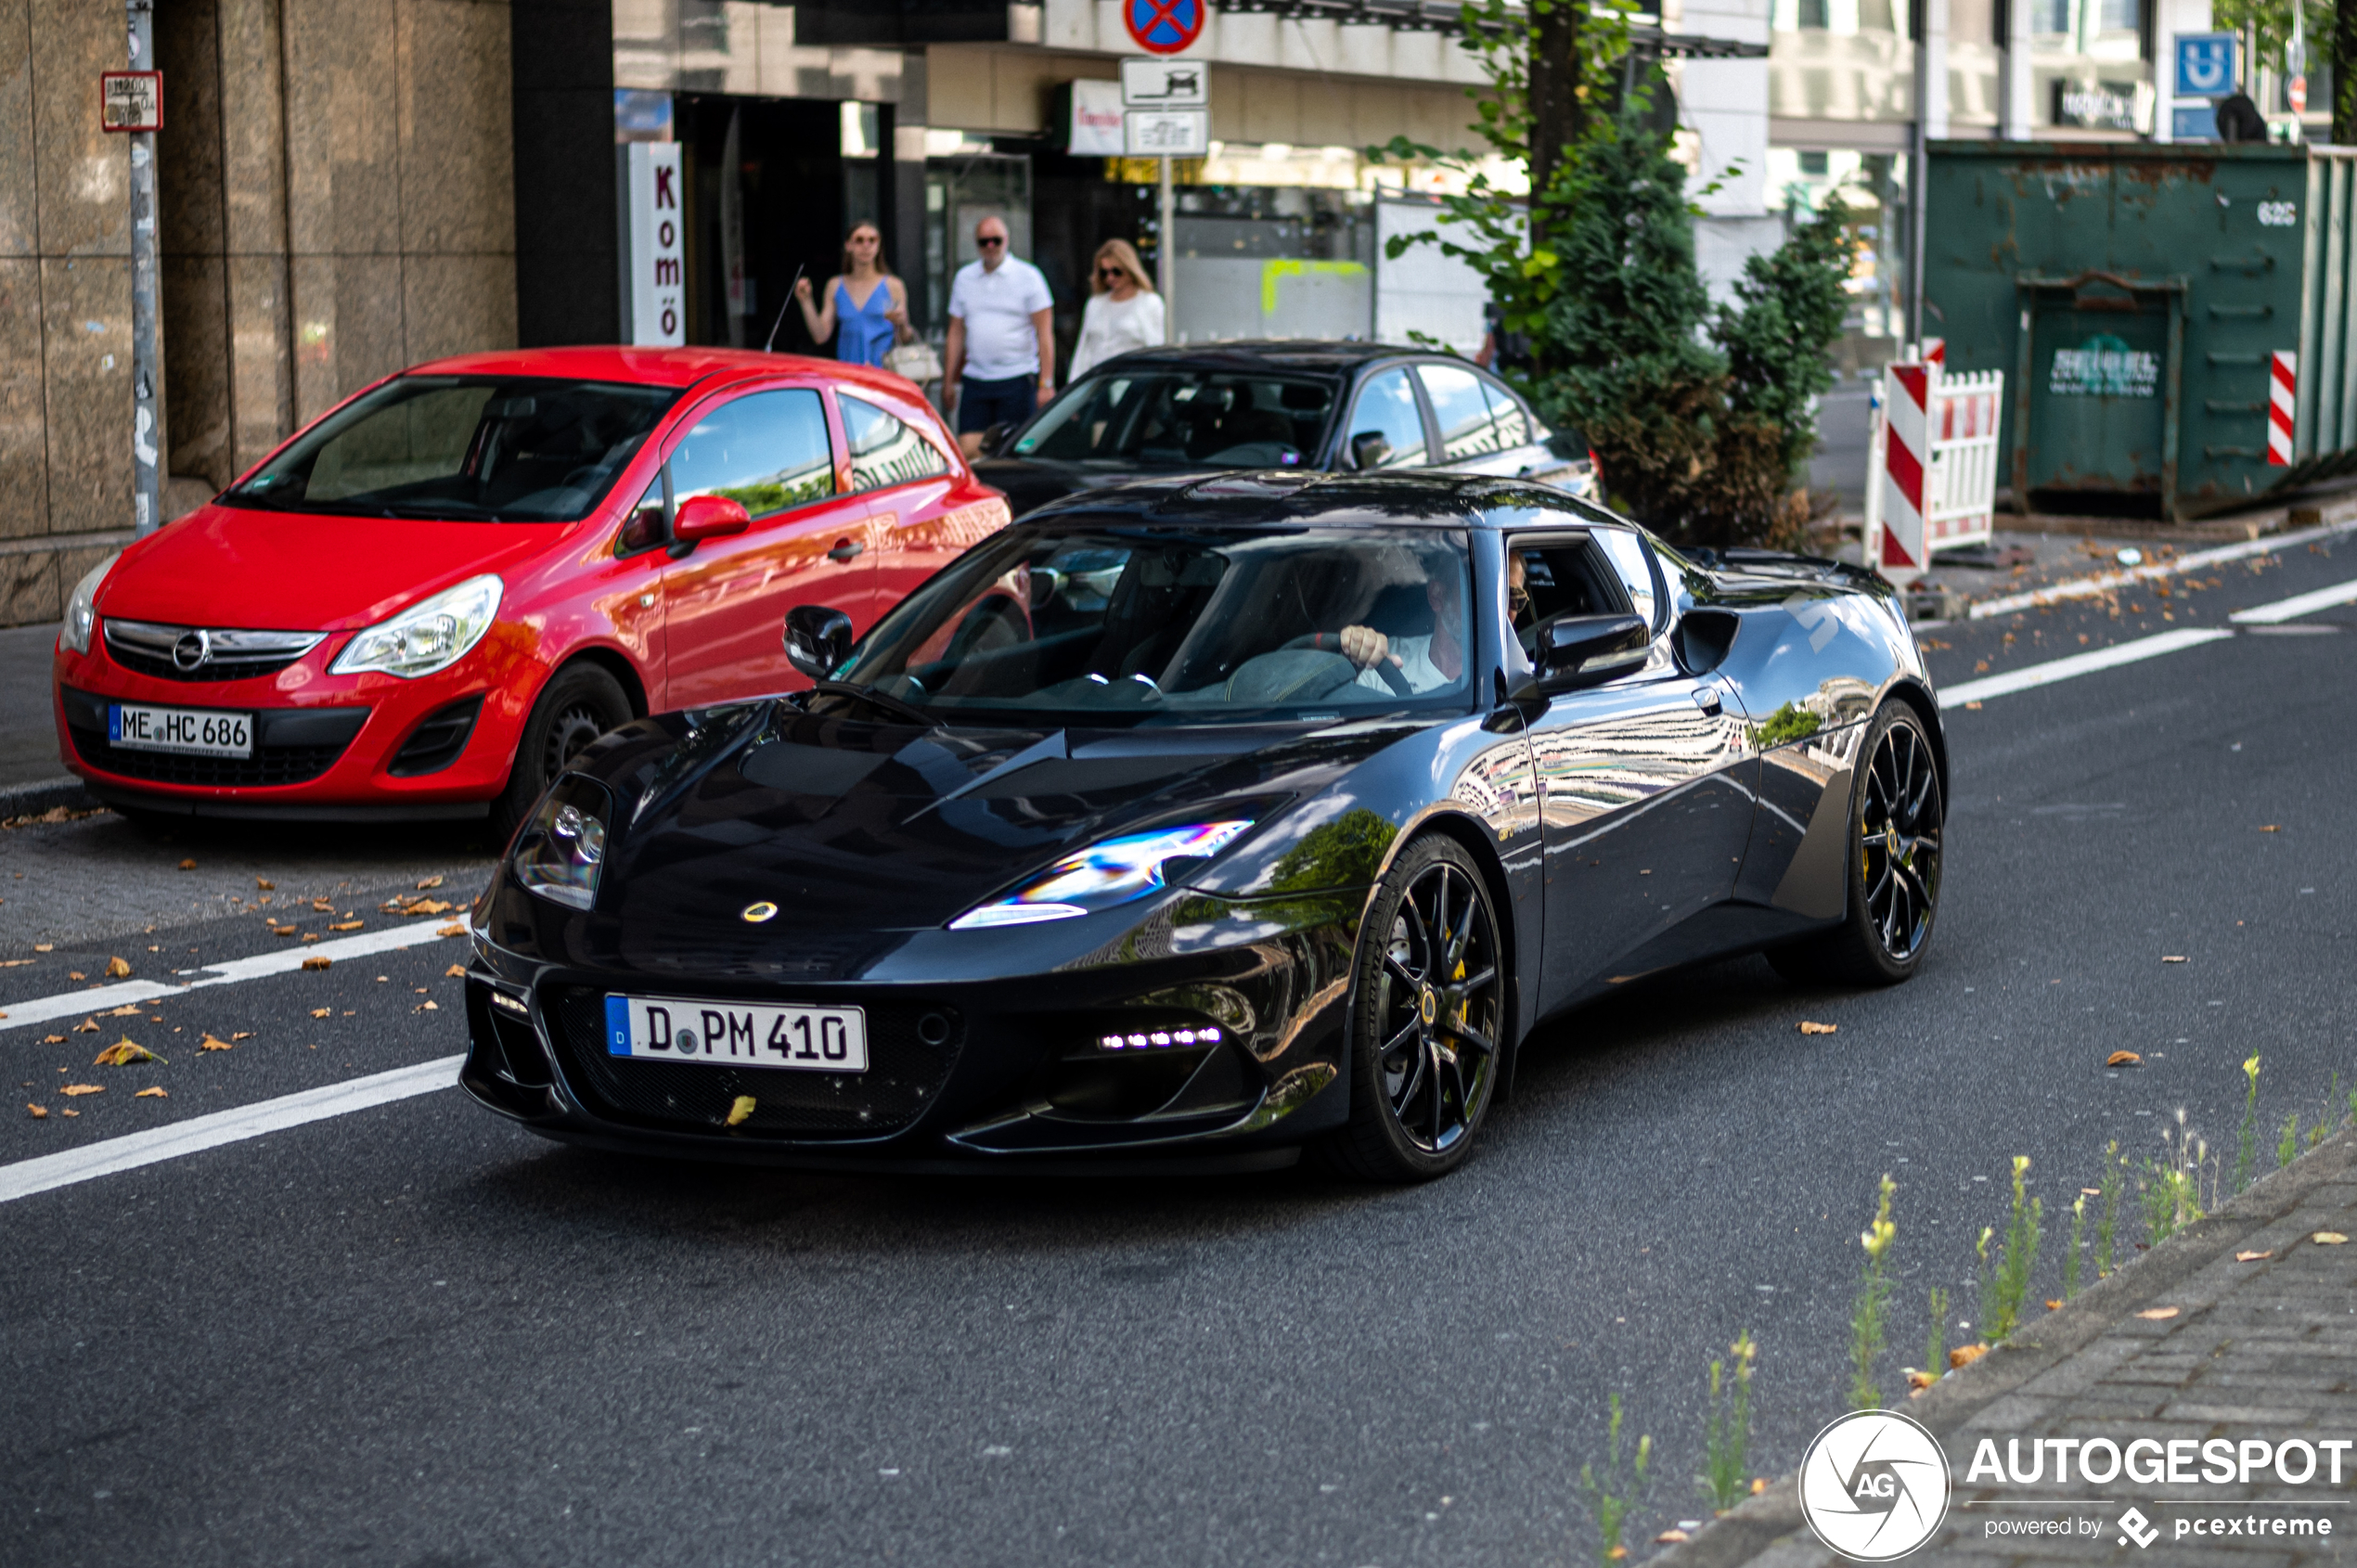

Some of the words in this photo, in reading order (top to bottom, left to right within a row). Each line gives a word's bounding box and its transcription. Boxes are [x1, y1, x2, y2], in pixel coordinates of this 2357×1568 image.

[2184, 44, 2223, 88] U
[122, 710, 151, 739] ME
[166, 713, 197, 742] HC
[202, 717, 247, 747] 686
[1369, 944, 1383, 1037] MICHELIN
[616, 1031, 625, 1045] D
[646, 1006, 673, 1050] D
[700, 1009, 756, 1057] PM
[766, 1013, 848, 1061] 410
